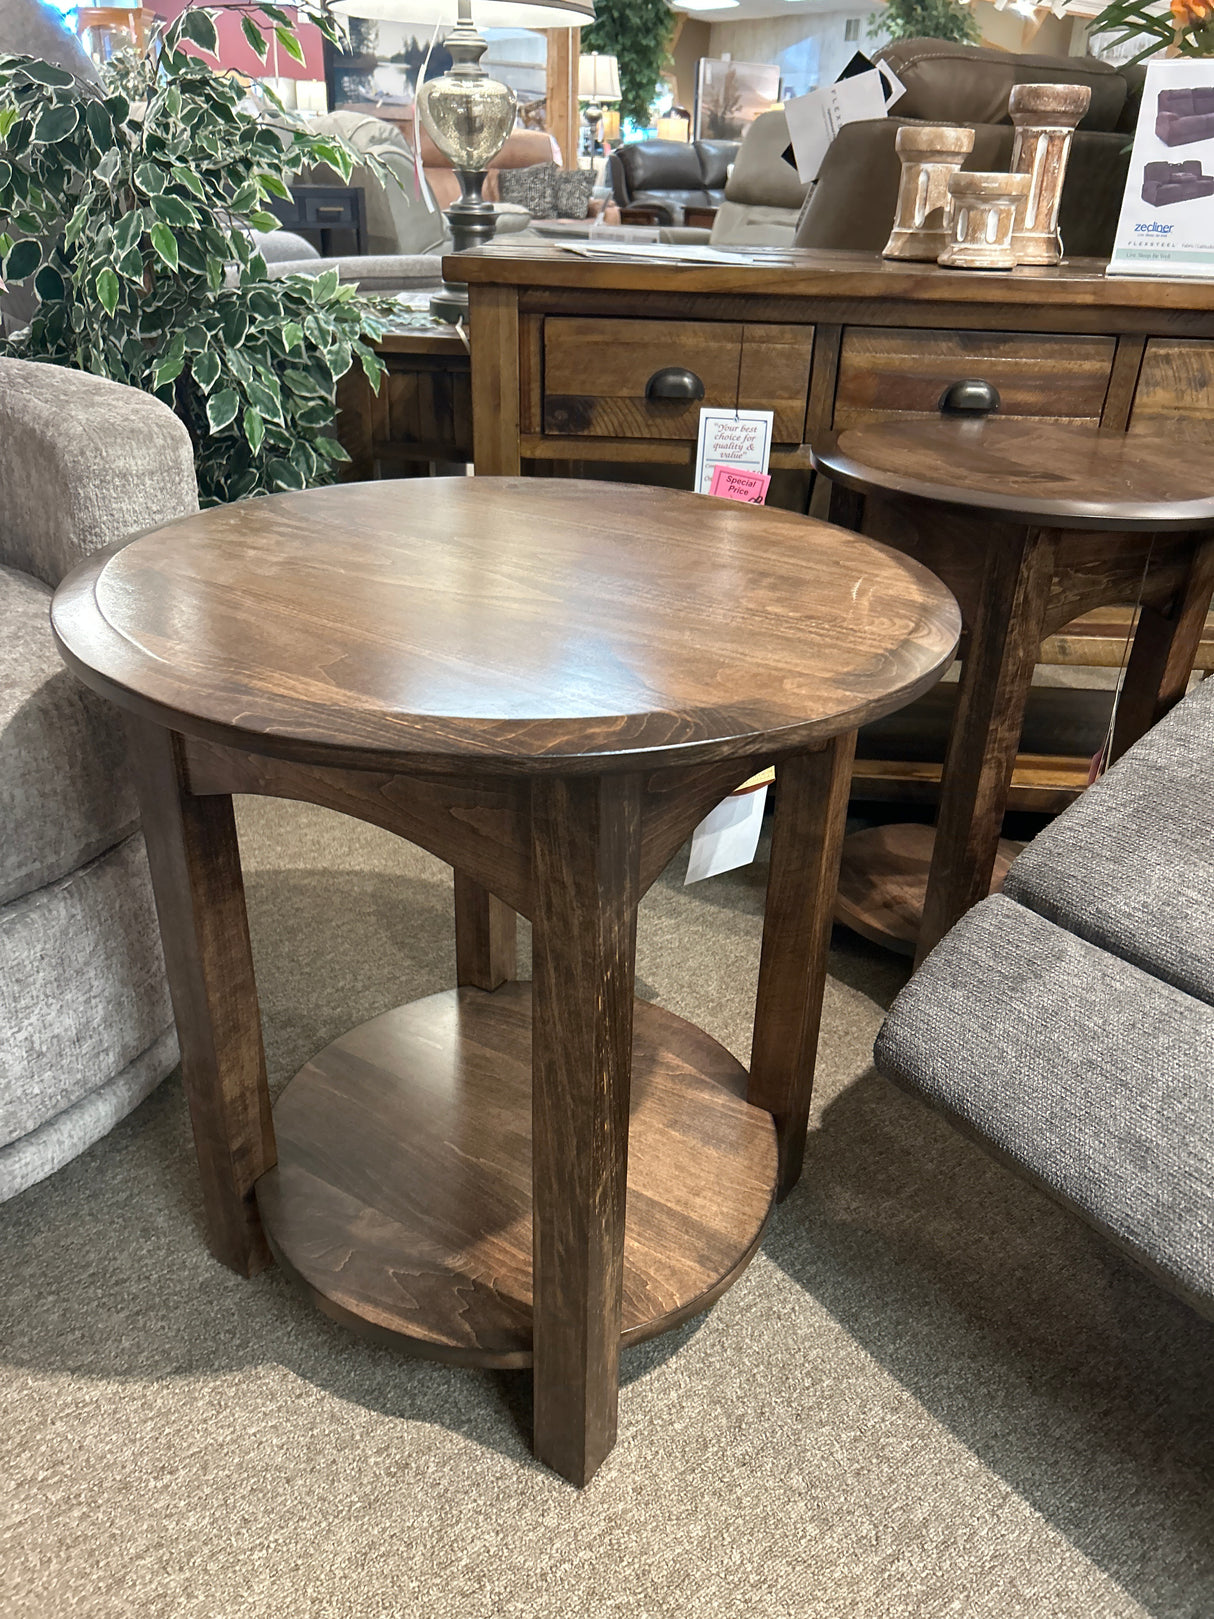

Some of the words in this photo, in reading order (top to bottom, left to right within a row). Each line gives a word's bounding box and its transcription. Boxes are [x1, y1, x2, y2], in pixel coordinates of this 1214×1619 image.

[1134, 221, 1175, 233] zecliner
[714, 422, 739, 433] "Your
[740, 424, 758, 433] best
[714, 432, 741, 441] choice
[741, 433, 756, 444] for
[713, 442, 743, 452] quality
[746, 443, 755, 451] &
[720, 450, 748, 459] value"
[726, 475, 757, 488] Special
[728, 485, 749, 496] Price
